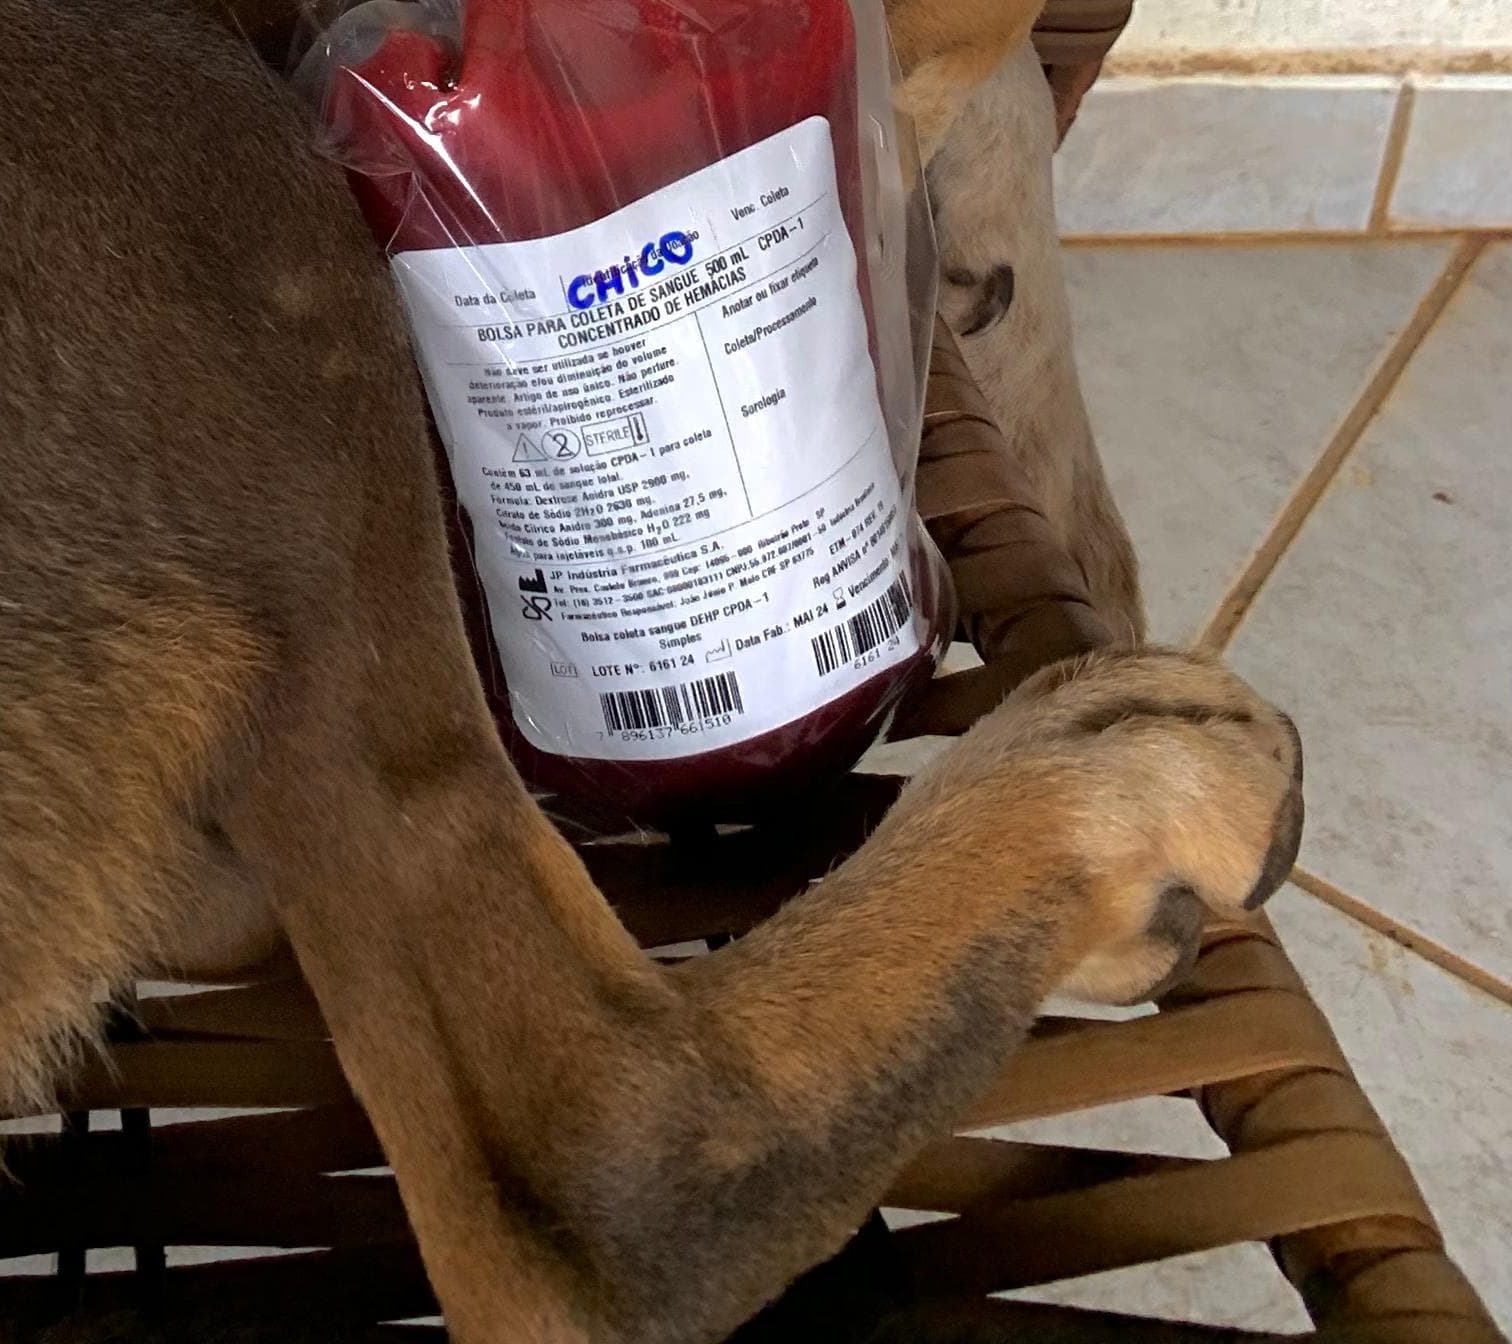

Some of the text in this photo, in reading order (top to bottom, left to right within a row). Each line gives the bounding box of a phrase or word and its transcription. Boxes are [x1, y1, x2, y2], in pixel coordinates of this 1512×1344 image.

[760, 186, 790, 207] Coleta
[455, 290, 536, 307] Data da Coleta
[477, 324, 523, 342] BOLSA
[526, 318, 567, 337] PARA
[571, 302, 625, 328] COLETA
[628, 292, 646, 311] DE
[649, 268, 700, 303] SANGUE
[705, 256, 728, 276] 500
[730, 246, 750, 266] mL
[721, 257, 819, 319] Anotar ou fixar etiqueta
[558, 266, 747, 349] CONCENTRADO DE HEMÁCIAS
[724, 295, 817, 355] Coleta/Processamento
[468, 379, 528, 391] deterioração
[556, 364, 613, 384] diminuição
[616, 359, 629, 370] do
[632, 345, 667, 365] volume
[532, 364, 548, 374] ser
[552, 354, 595, 371] utilizada
[597, 350, 609, 360] se
[612, 338, 646, 356] houver
[478, 408, 514, 418] Produto
[618, 374, 675, 399] Esterilizado
[513, 392, 543, 404] Artigo
[545, 390, 559, 399] de
[562, 387, 580, 397] uso
[617, 372, 638, 384] Não
[741, 388, 787, 418] Sorologia
[550, 412, 593, 427] Proibido
[595, 396, 658, 419] reprocessar.
[586, 426, 631, 447] STERILE
[481, 466, 517, 478] Contém
[552, 466, 566, 476] de
[569, 460, 608, 474] solução
[659, 441, 681, 457] para
[683, 428, 713, 447] coleta
[490, 480, 501, 490] de
[525, 481, 541, 492] mL
[543, 481, 556, 491] de
[559, 478, 595, 490] sangue
[535, 494, 578, 506] Dextrose
[582, 489, 615, 501] Anidra
[617, 482, 639, 496] USP
[496, 508, 526, 520] Citrato
[528, 510, 541, 520] de
[543, 508, 572, 520] Sódio
[524, 523, 556, 534] Cítrico
[559, 521, 591, 533] Anidro
[640, 503, 681, 520] Adenina
[537, 537, 549, 547] de
[551, 535, 580, 548] Sódio
[582, 527, 643, 545] Monobásico
[672, 513, 692, 528] 222
[533, 552, 554, 562] para
[556, 548, 604, 562] injetáveis
[549, 541, 725, 581] JP Indústria Farmacêutica S.A.
[779, 558, 791, 571] SP
[831, 549, 861, 577] ANVISA
[581, 631, 610, 643] Bolsa
[613, 628, 646, 641] coleta
[648, 620, 687, 636] sangue
[690, 609, 720, 627] DEHP
[659, 633, 702, 650] Simples
[735, 634, 761, 651] Data
[793, 609, 814, 629] MAI
[816, 603, 829, 617] 24
[592, 664, 621, 677] LOTE
[649, 659, 677, 672] 6161
[680, 654, 695, 666] 24
[853, 635, 901, 670] 6161 24
